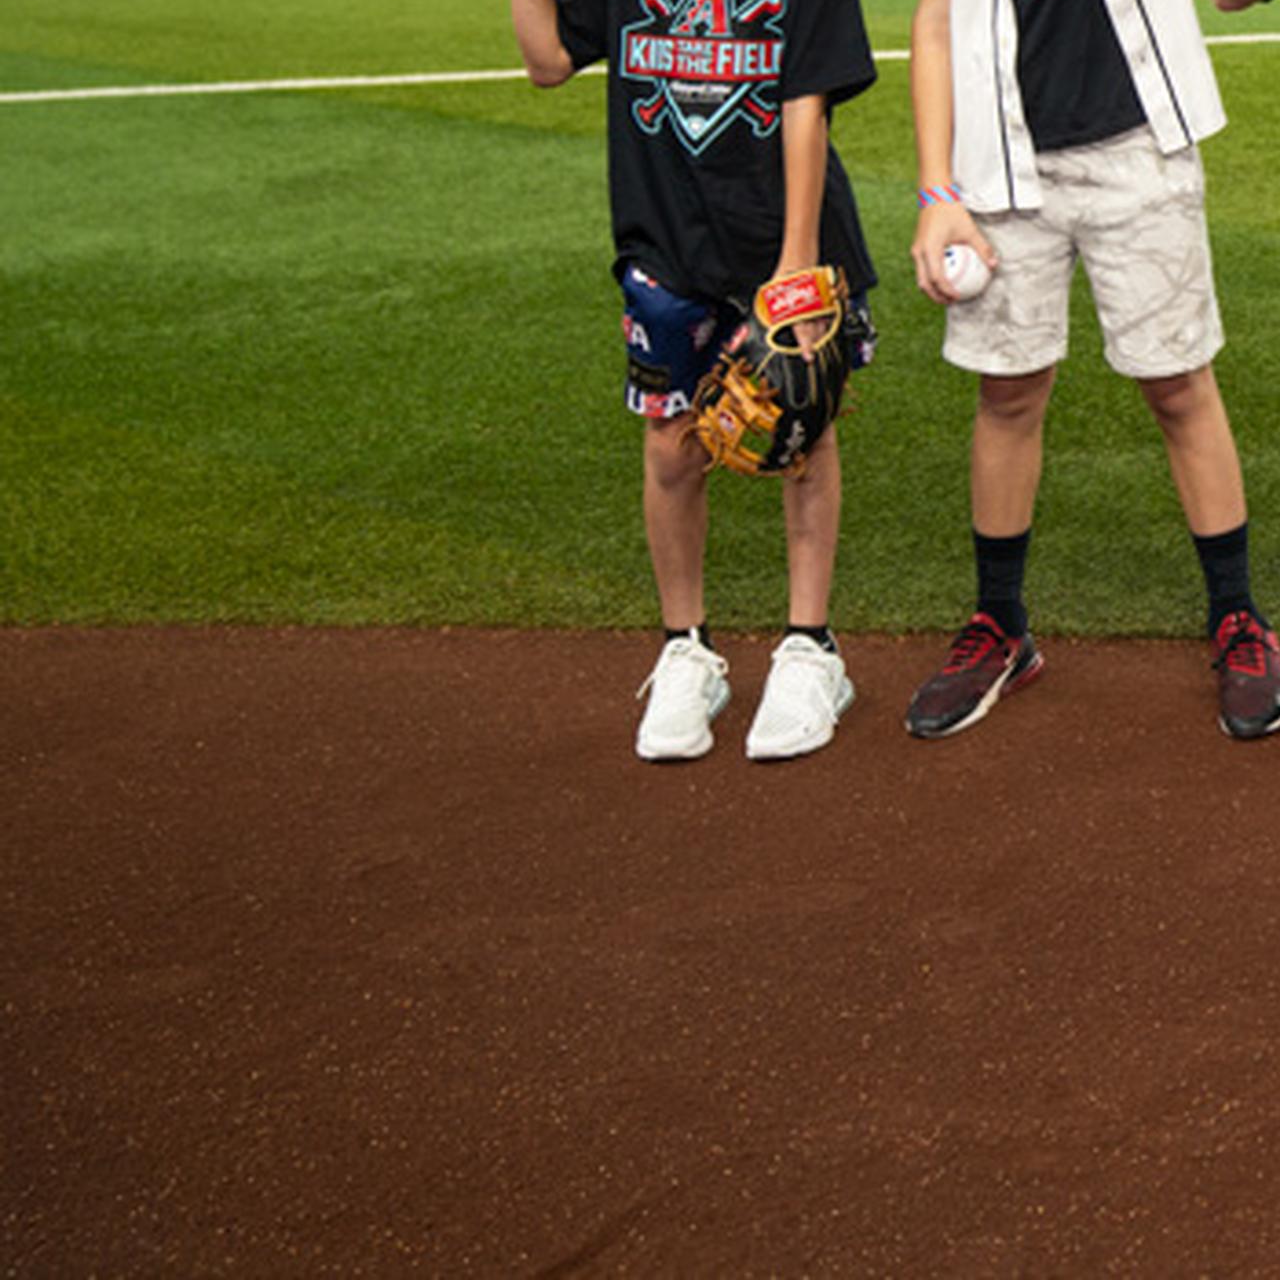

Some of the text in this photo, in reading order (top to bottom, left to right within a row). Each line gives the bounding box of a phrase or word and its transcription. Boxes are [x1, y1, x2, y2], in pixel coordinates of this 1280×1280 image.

[676, 39, 714, 54] TAKE
[676, 54, 714, 74] THE
[626, 385, 690, 418] USA
